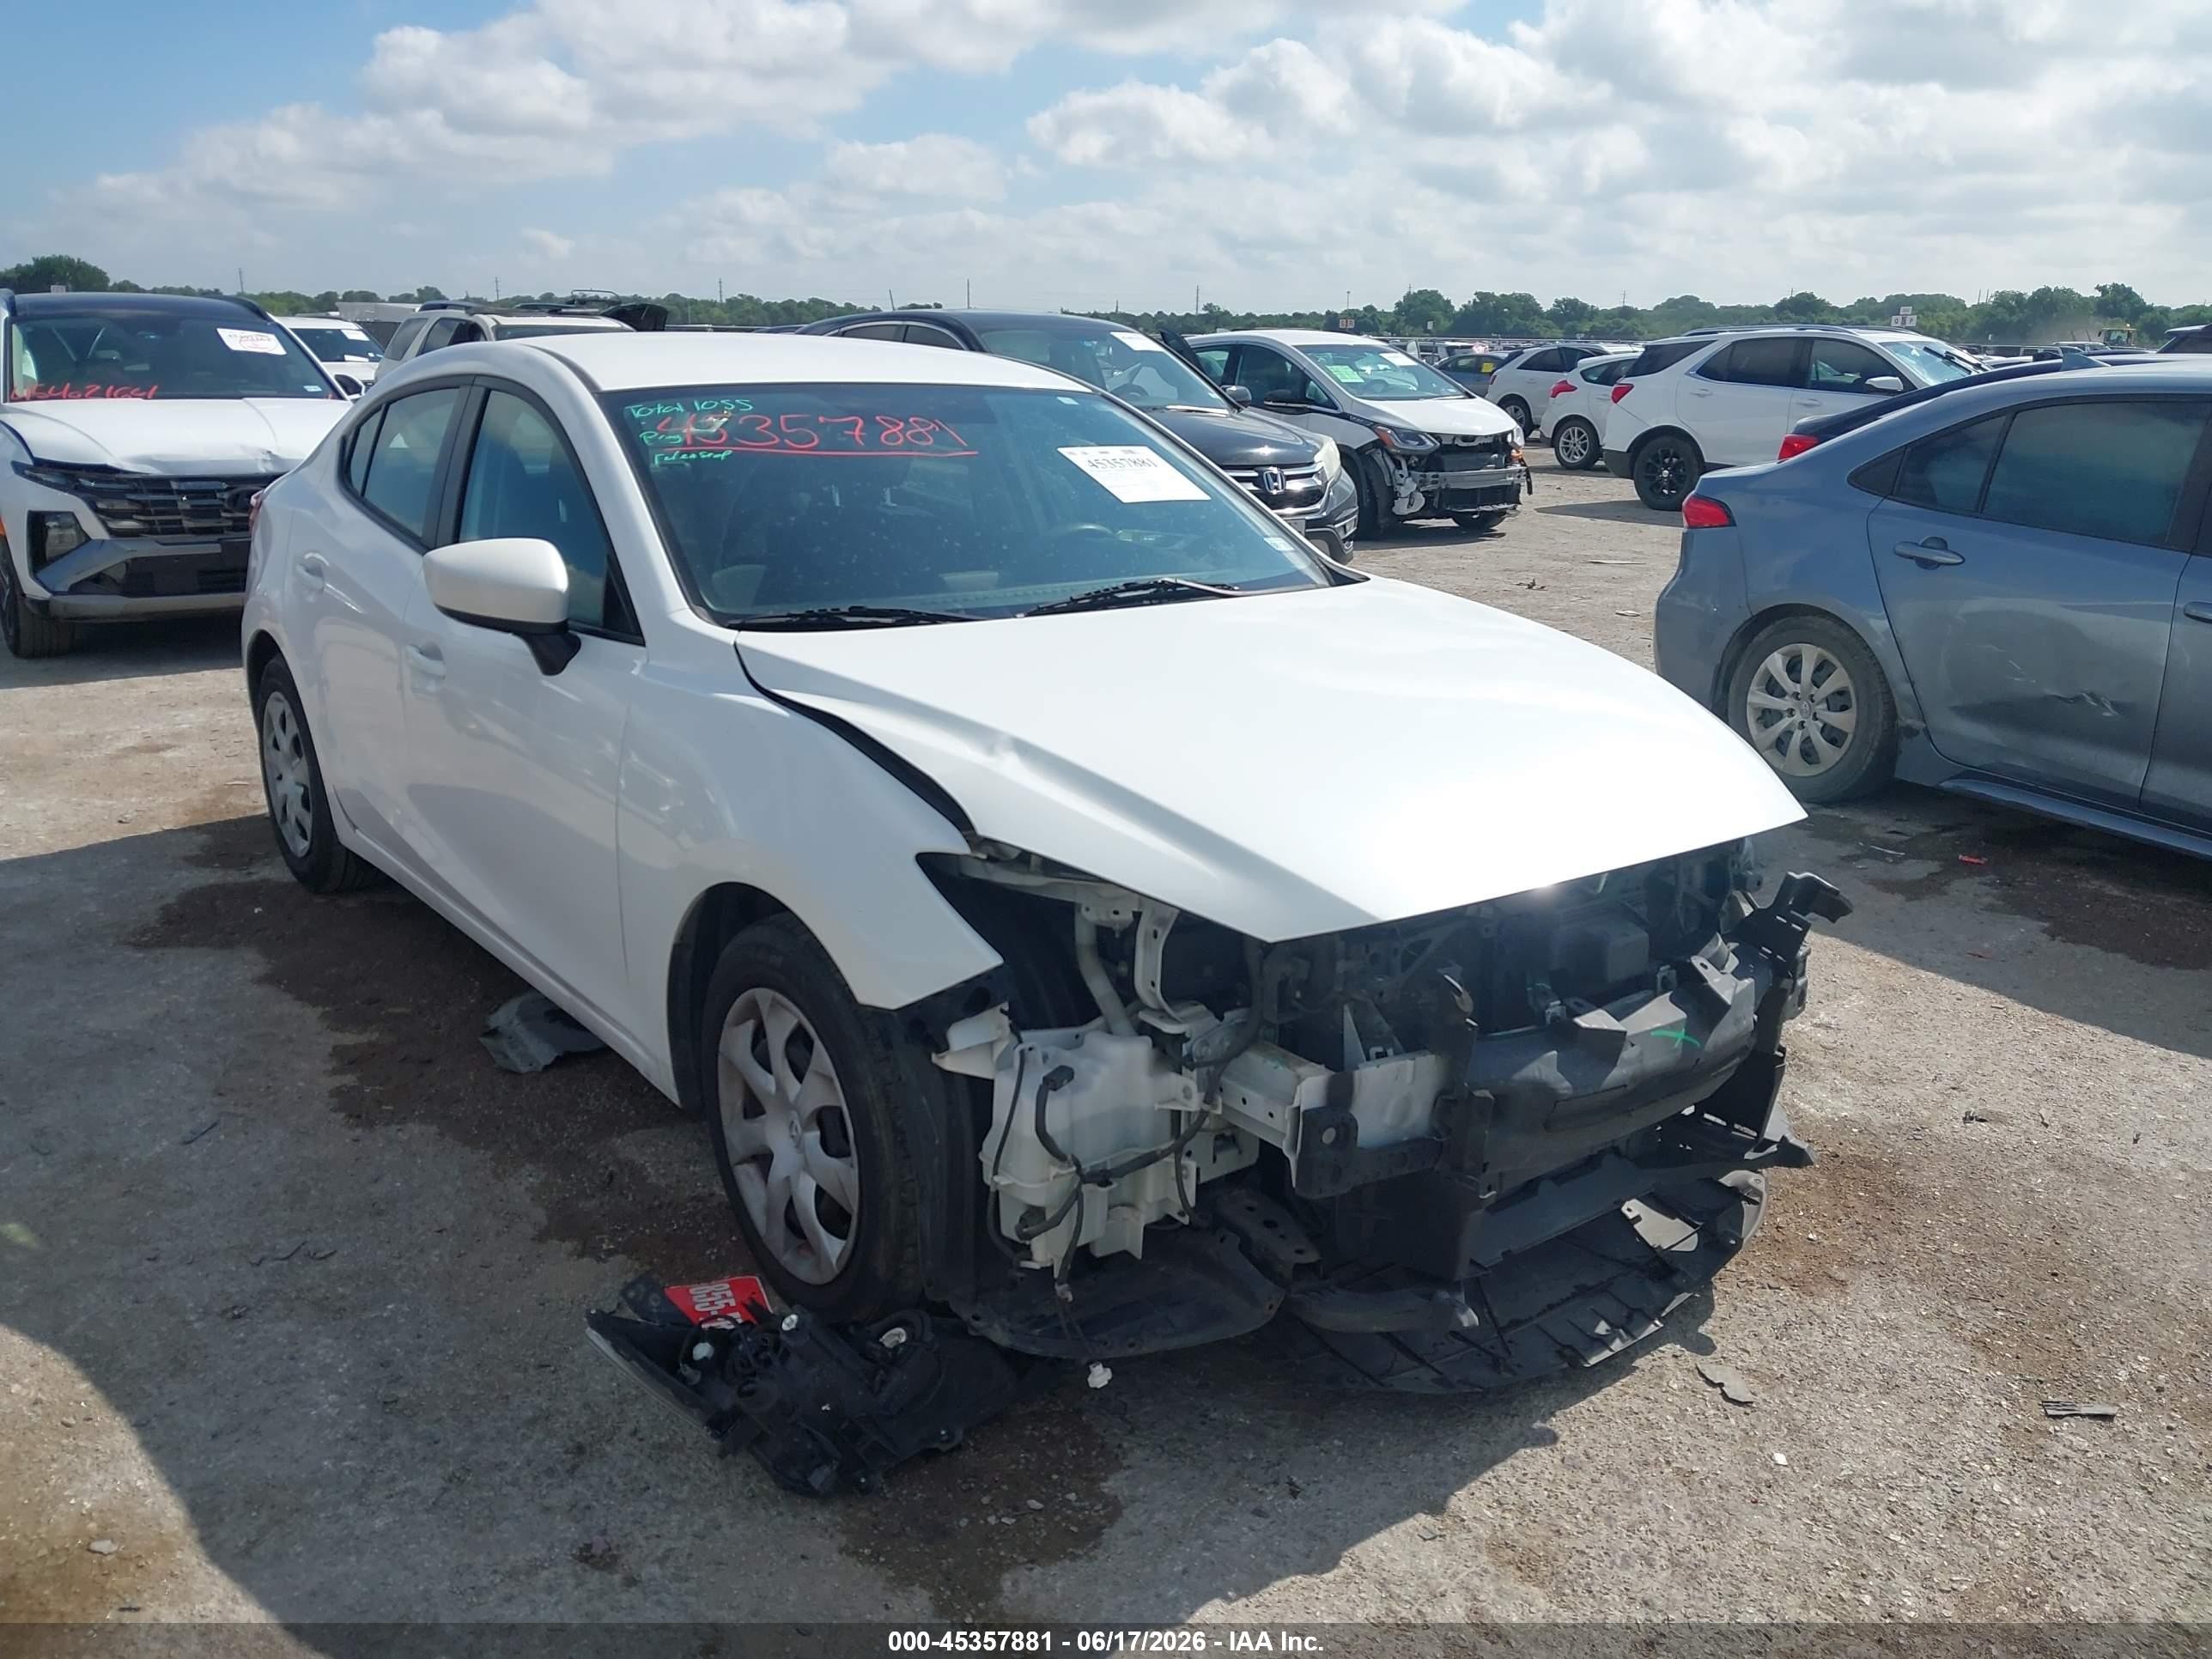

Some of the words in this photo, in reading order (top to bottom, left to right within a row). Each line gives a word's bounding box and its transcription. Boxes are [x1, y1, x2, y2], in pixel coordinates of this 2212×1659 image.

[625, 402, 684, 418] Total
[694, 399, 754, 412] loss
[657, 414, 968, 447] 45357881
[1086, 457, 1158, 470] 45357881
